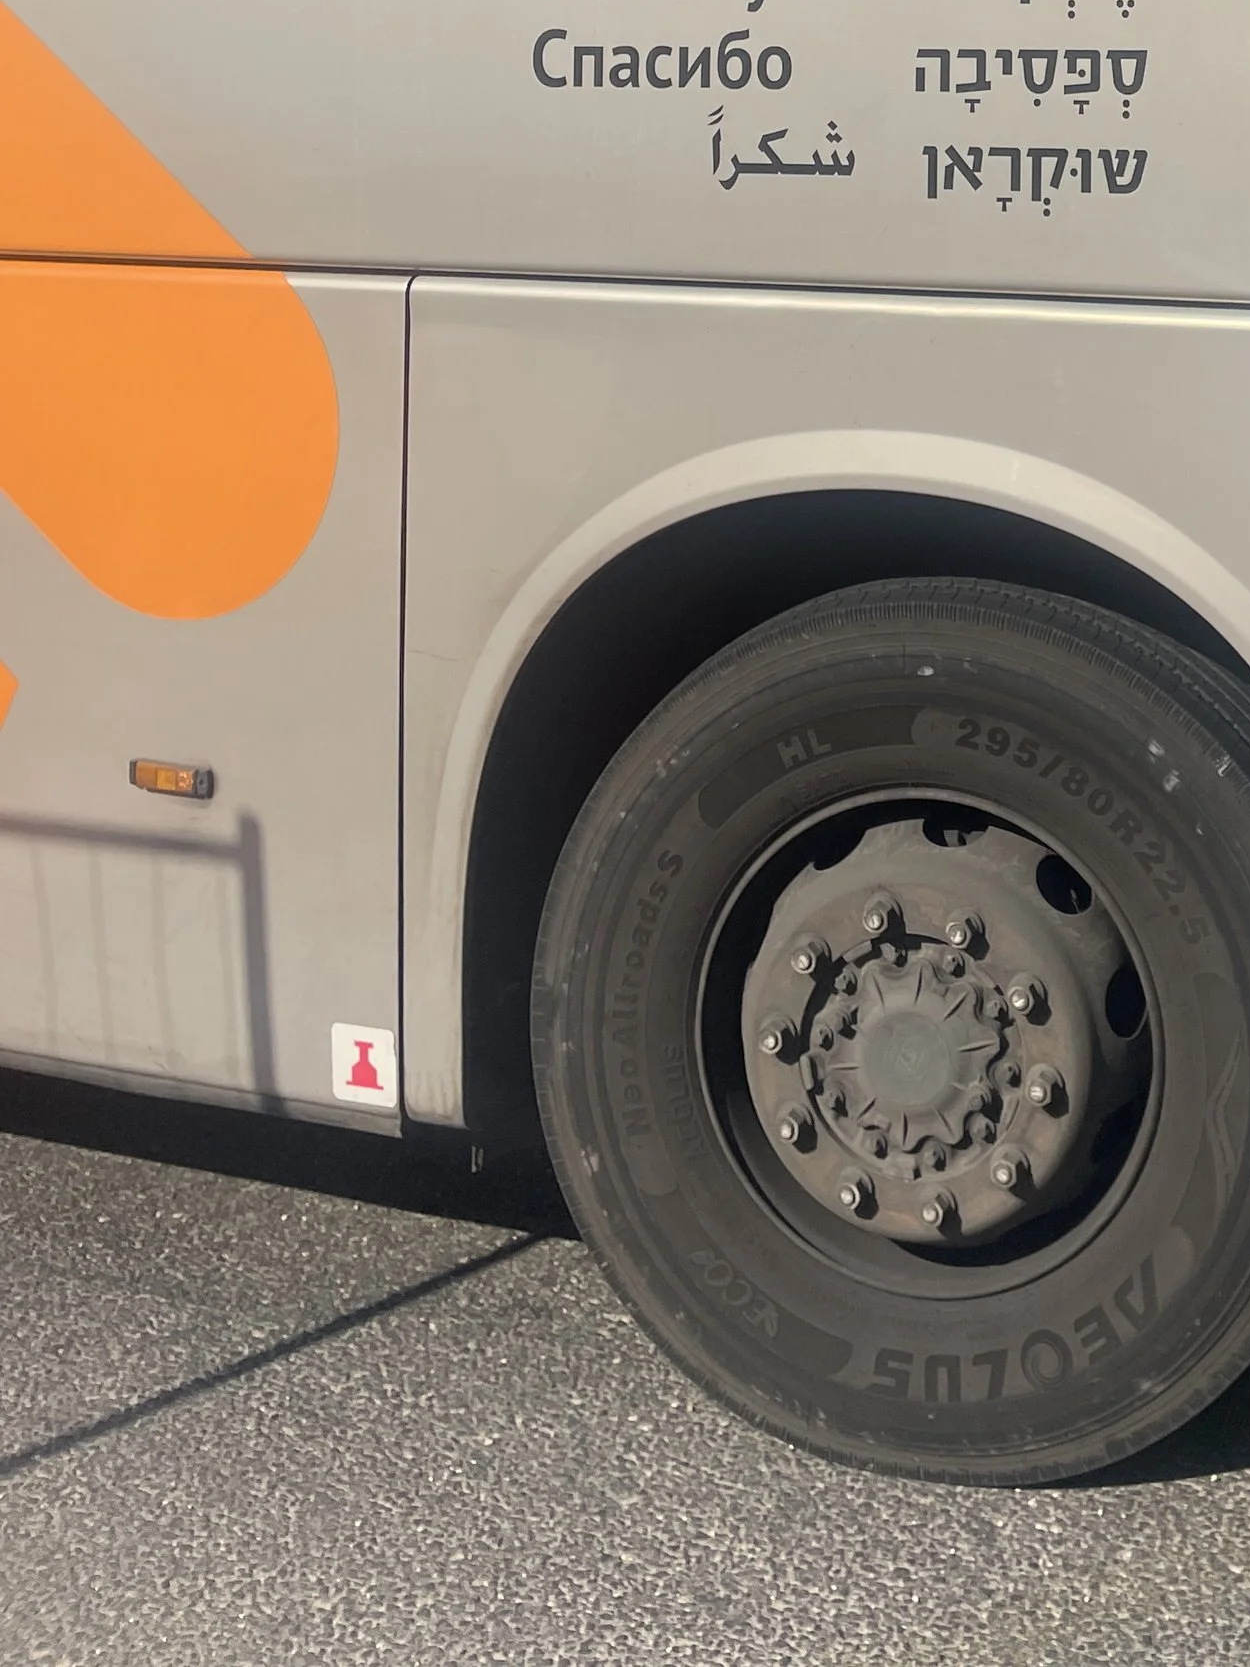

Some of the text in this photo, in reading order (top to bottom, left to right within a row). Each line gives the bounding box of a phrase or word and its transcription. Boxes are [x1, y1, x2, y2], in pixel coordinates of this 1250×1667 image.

[533, 29, 792, 90] Спасибо
[776, 728, 832, 768] HL
[956, 718, 1210, 948] 295/80R22.5
[864, 1253, 1159, 1402] AEOLUS
